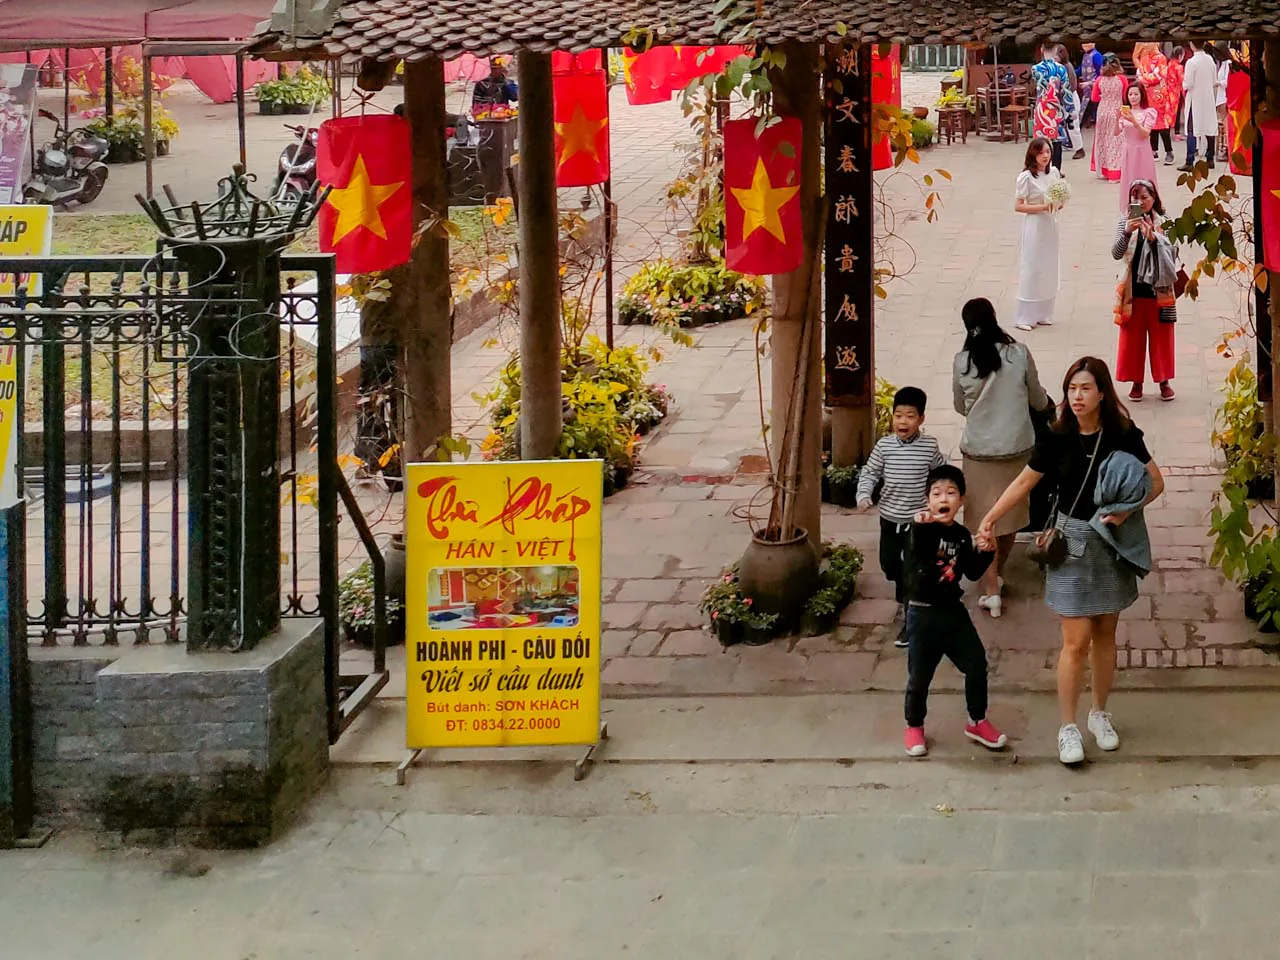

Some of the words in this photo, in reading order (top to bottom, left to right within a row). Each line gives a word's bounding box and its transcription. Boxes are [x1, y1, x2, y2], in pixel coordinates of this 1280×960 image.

[0, 216, 28, 242] ÁP
[479, 476, 591, 561] Pháp
[446, 539, 495, 559] HÁN
[516, 537, 564, 560] VIỆT
[416, 637, 472, 662] HOÀNH
[478, 640, 505, 660] PHI
[523, 635, 556, 659] CÂU
[562, 631, 590, 659] ĐỐI
[421, 666, 463, 693] Viết
[468, 668, 493, 693] sớ
[497, 665, 531, 691] cầu
[537, 667, 584, 690] danh
[427, 701, 450, 713] Bút
[454, 701, 491, 712] danh:
[495, 699, 526, 712] SƠN
[530, 696, 579, 711] KHÁCH
[446, 719, 468, 732] ĐT:
[472, 717, 561, 731] 0834.22.0000
